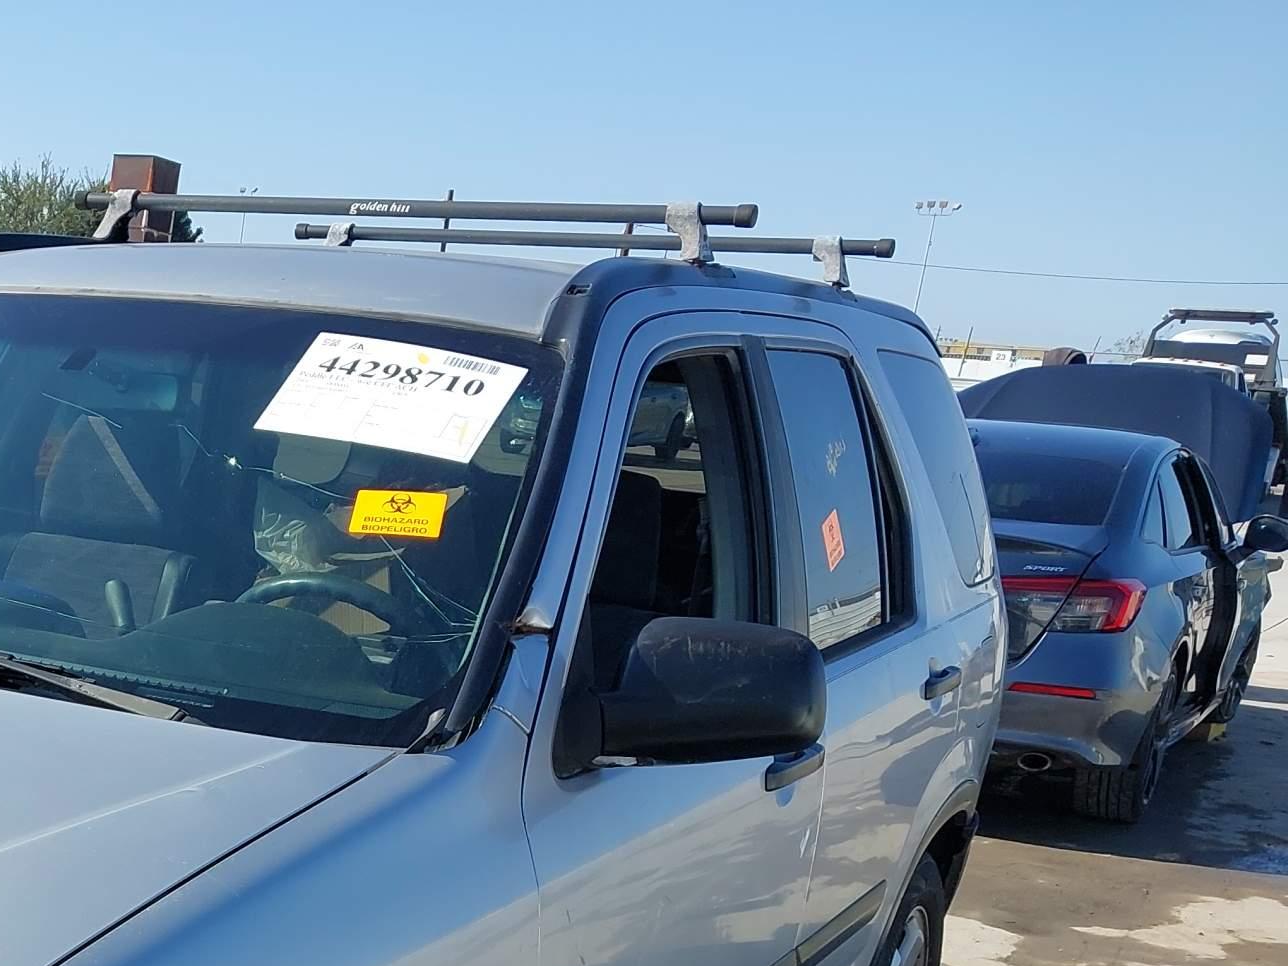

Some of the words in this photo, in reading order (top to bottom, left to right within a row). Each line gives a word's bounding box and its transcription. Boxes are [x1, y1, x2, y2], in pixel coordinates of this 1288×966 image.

[349, 201, 389, 215] golden
[389, 202, 411, 213] hill
[318, 356, 485, 396] 44298710
[363, 516, 429, 525] BIOHAZARD
[361, 524, 428, 534] BIOPELIGRO
